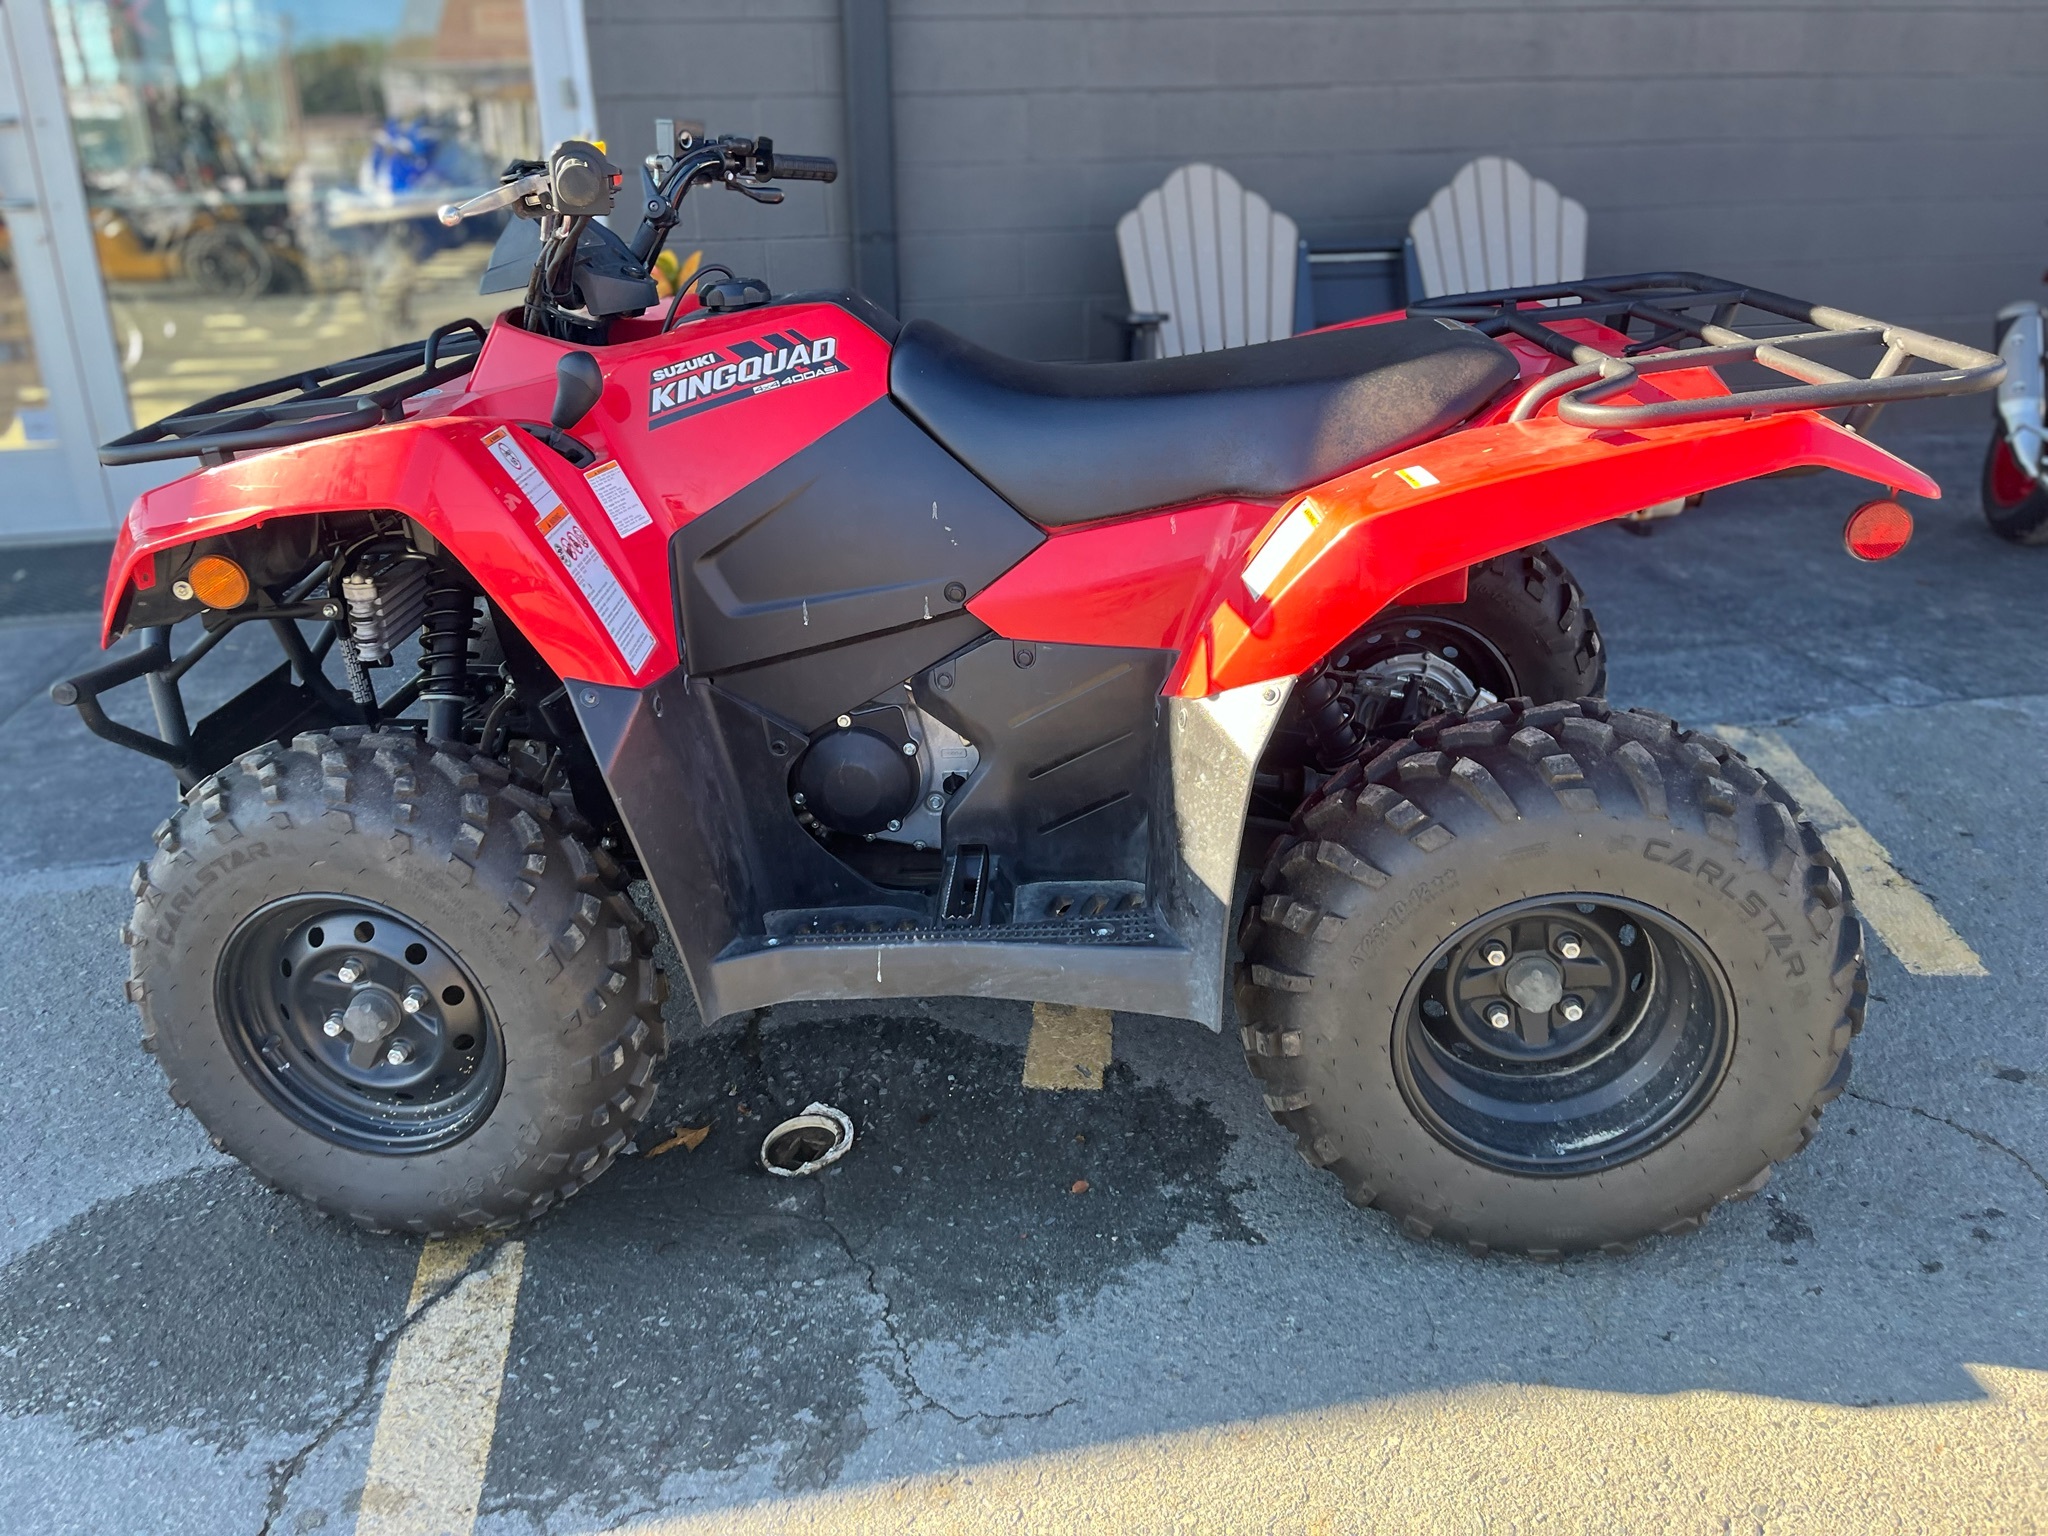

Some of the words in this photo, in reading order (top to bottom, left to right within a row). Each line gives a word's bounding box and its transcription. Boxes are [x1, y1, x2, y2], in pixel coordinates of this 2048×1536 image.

[651, 337, 837, 413] KINGQUAD
[652, 353, 716, 382] SUZUKI
[155, 841, 271, 947] CARLSTAR
[1642, 837, 1806, 979] CARLSTAR
